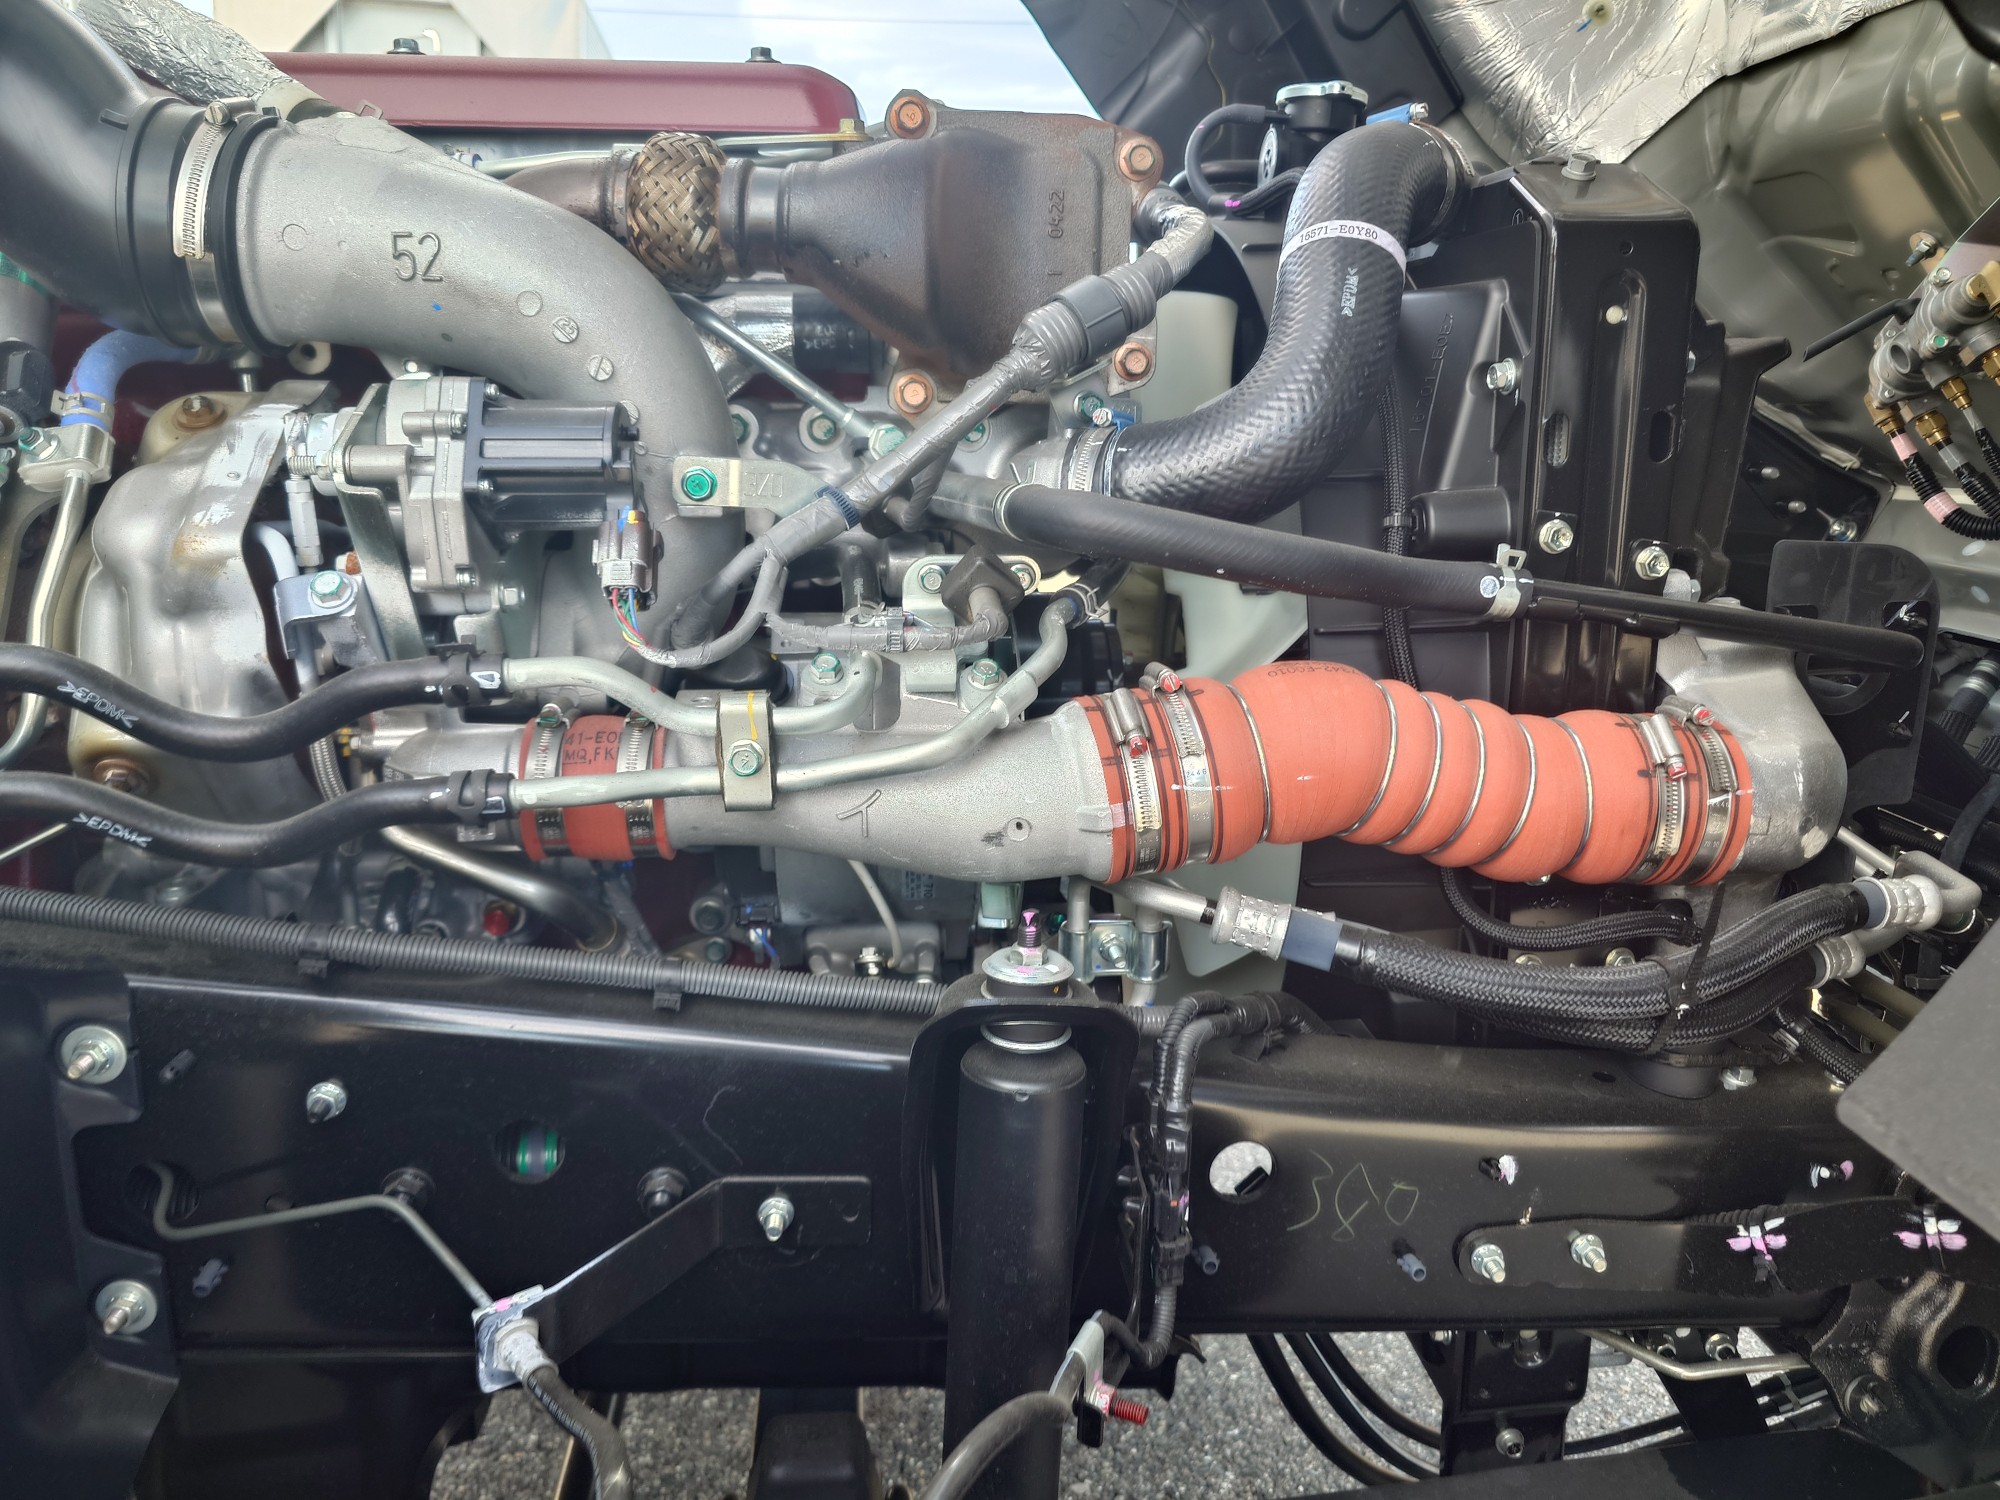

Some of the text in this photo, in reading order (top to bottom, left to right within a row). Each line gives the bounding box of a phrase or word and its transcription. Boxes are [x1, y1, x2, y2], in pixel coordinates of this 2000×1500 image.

[1047, 189, 1065, 239] 0422
[1299, 224, 1379, 244] 16571-E0Y80
[391, 231, 444, 282] 52
[564, 731, 622, 746] 41-E0
